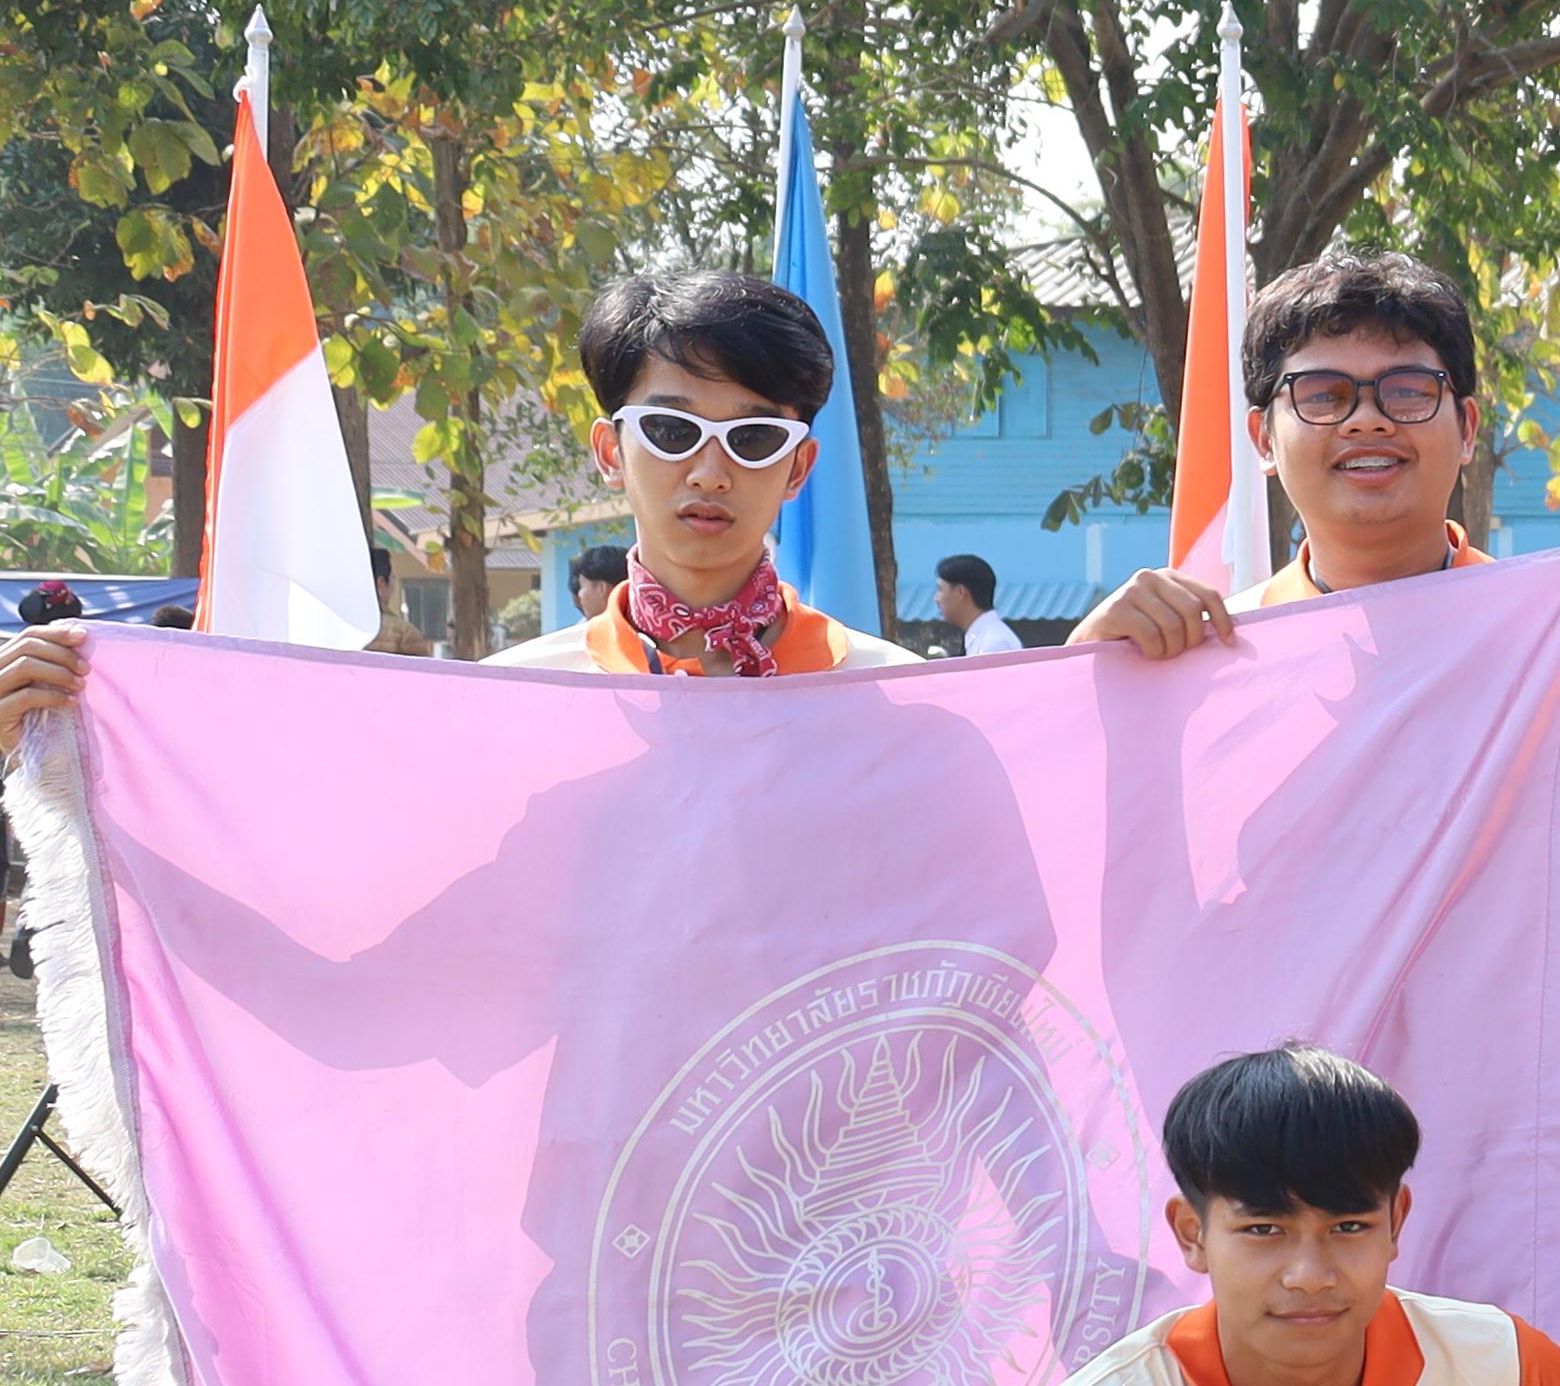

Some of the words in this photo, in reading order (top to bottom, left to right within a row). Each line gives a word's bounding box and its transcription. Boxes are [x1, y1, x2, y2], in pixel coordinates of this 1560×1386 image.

[669, 959, 1086, 1138] มหาวิทยาลัยราชภัฏเชียงใหม่
